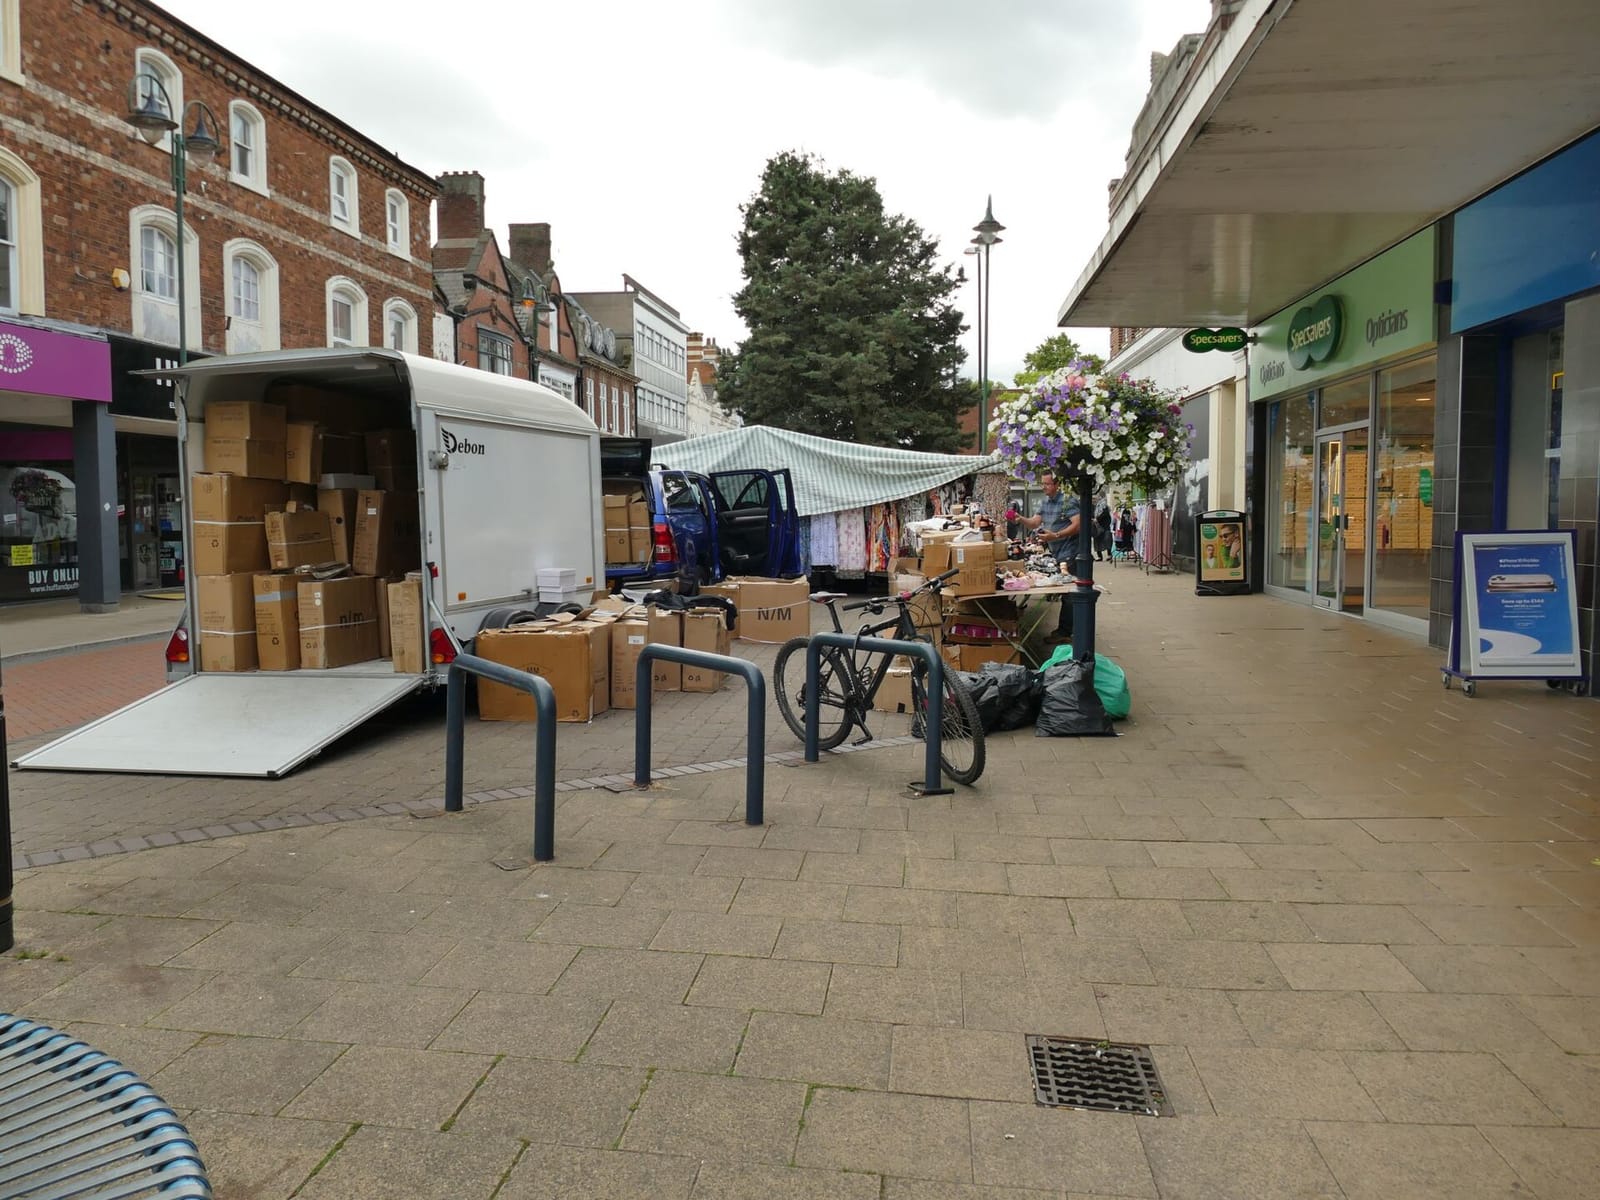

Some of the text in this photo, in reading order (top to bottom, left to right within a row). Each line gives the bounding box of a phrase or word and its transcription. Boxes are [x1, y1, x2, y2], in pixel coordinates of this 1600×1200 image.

[1190, 333, 1243, 346] Specsavers
[1291, 316, 1332, 352] Specsavers
[1365, 309, 1409, 348] Opticians
[1260, 360, 1286, 387] Opticians
[441, 426, 485, 455] Debon
[28, 569, 48, 585] BUY
[757, 607, 792, 621] N/M
